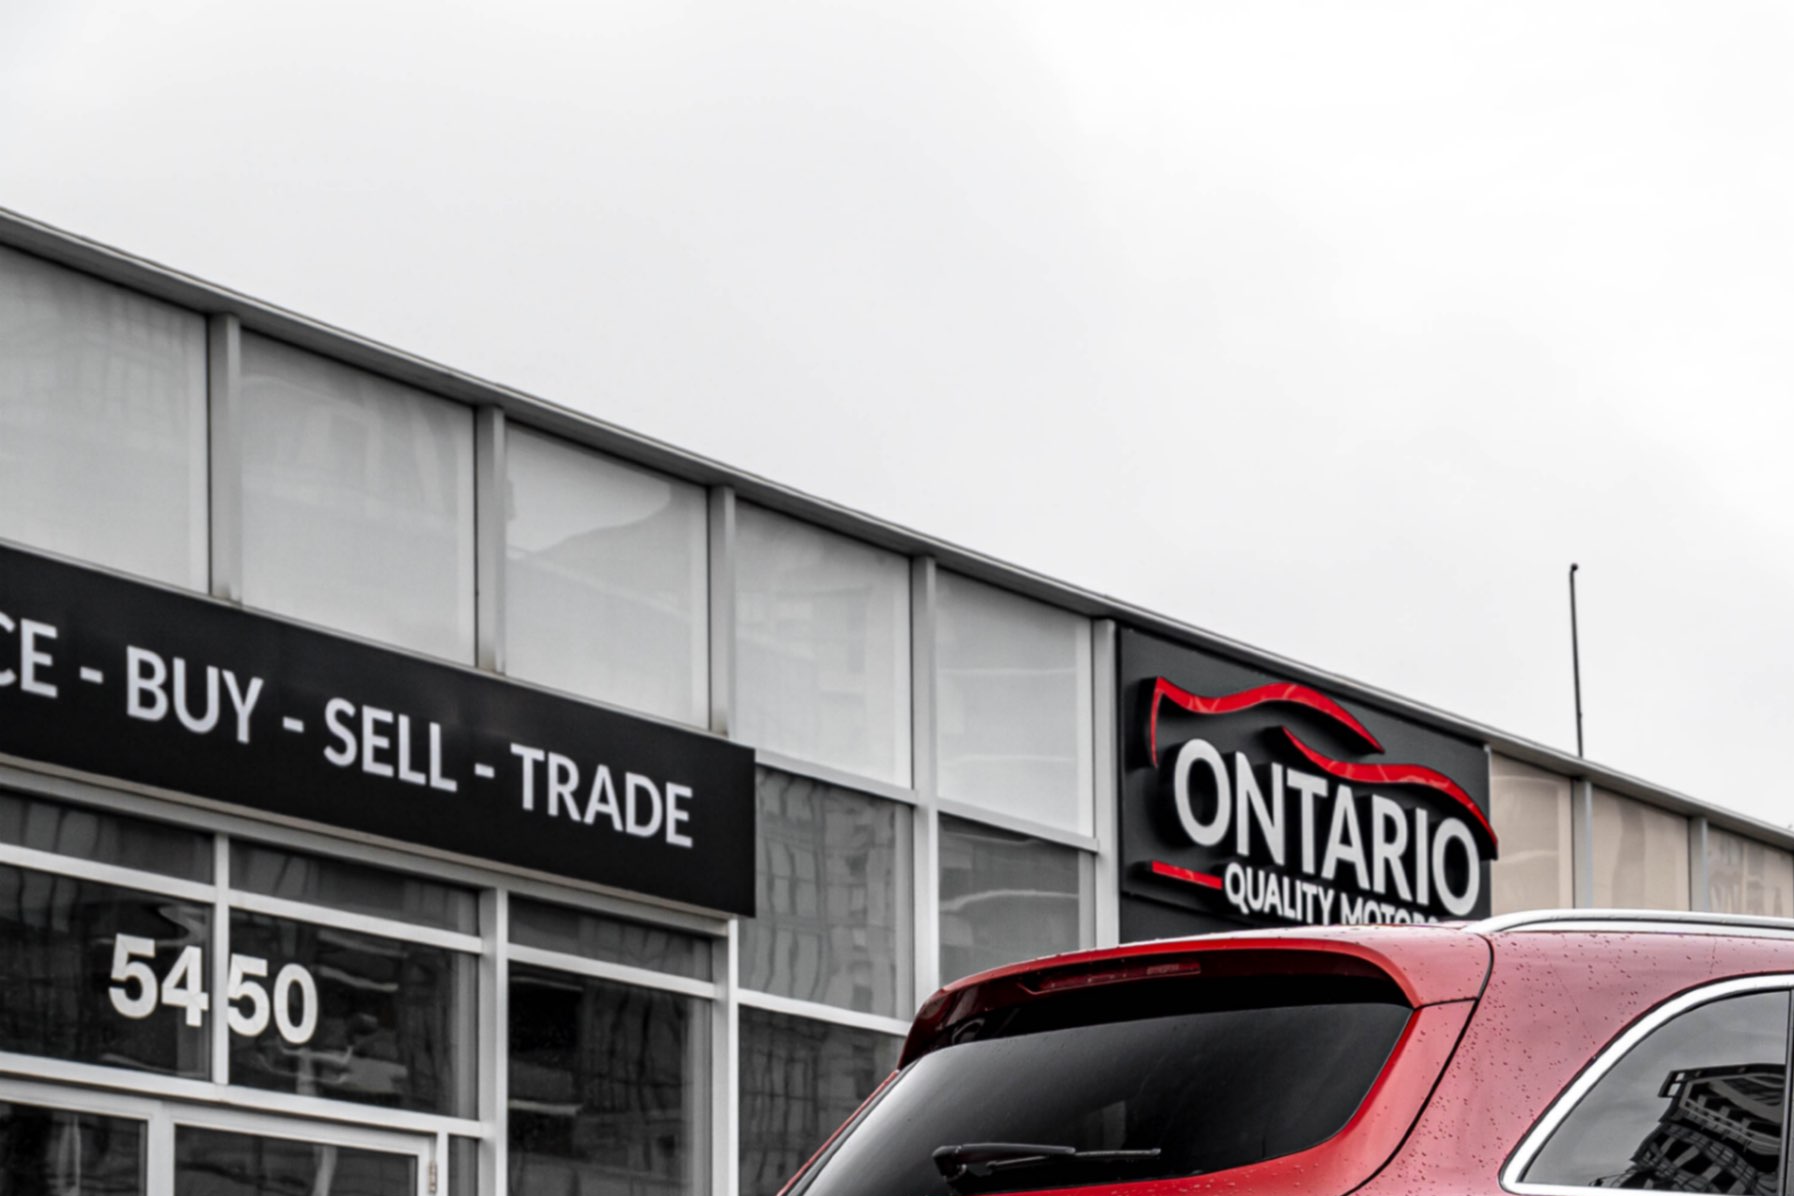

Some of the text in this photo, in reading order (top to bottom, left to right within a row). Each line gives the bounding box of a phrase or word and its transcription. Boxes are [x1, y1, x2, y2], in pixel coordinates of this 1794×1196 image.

[126, 645, 264, 743] BUY
[323, 697, 457, 792] SELL
[510, 742, 693, 848] TRADE
[1174, 738, 1480, 916] ONTARIO
[1224, 862, 1438, 926] QUALITY MOT
[108, 933, 318, 1044] 5450
